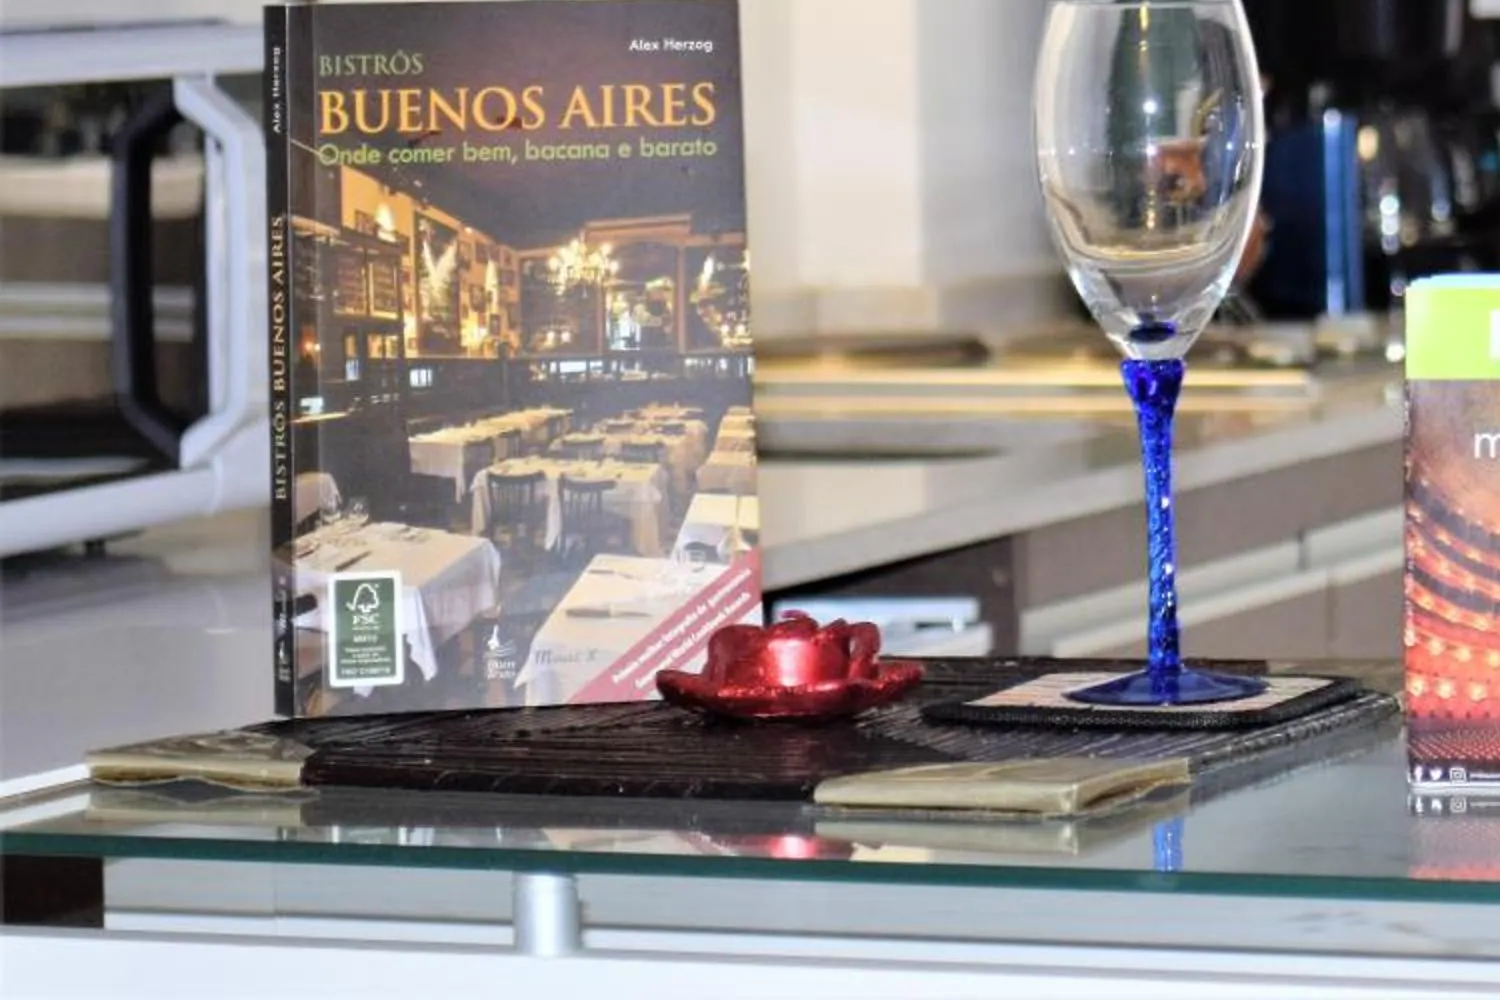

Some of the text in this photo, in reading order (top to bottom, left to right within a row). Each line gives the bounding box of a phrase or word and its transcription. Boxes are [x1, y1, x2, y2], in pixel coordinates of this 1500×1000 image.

[319, 49, 425, 76] BISTRÔS
[629, 38, 714, 55] Alex Herzog
[317, 81, 718, 135] BUENOS AIRES
[318, 135, 718, 166] Onde comer bem, bacana e barato
[271, 214, 285, 285] AIRES
[273, 288, 286, 391] BUENOS
